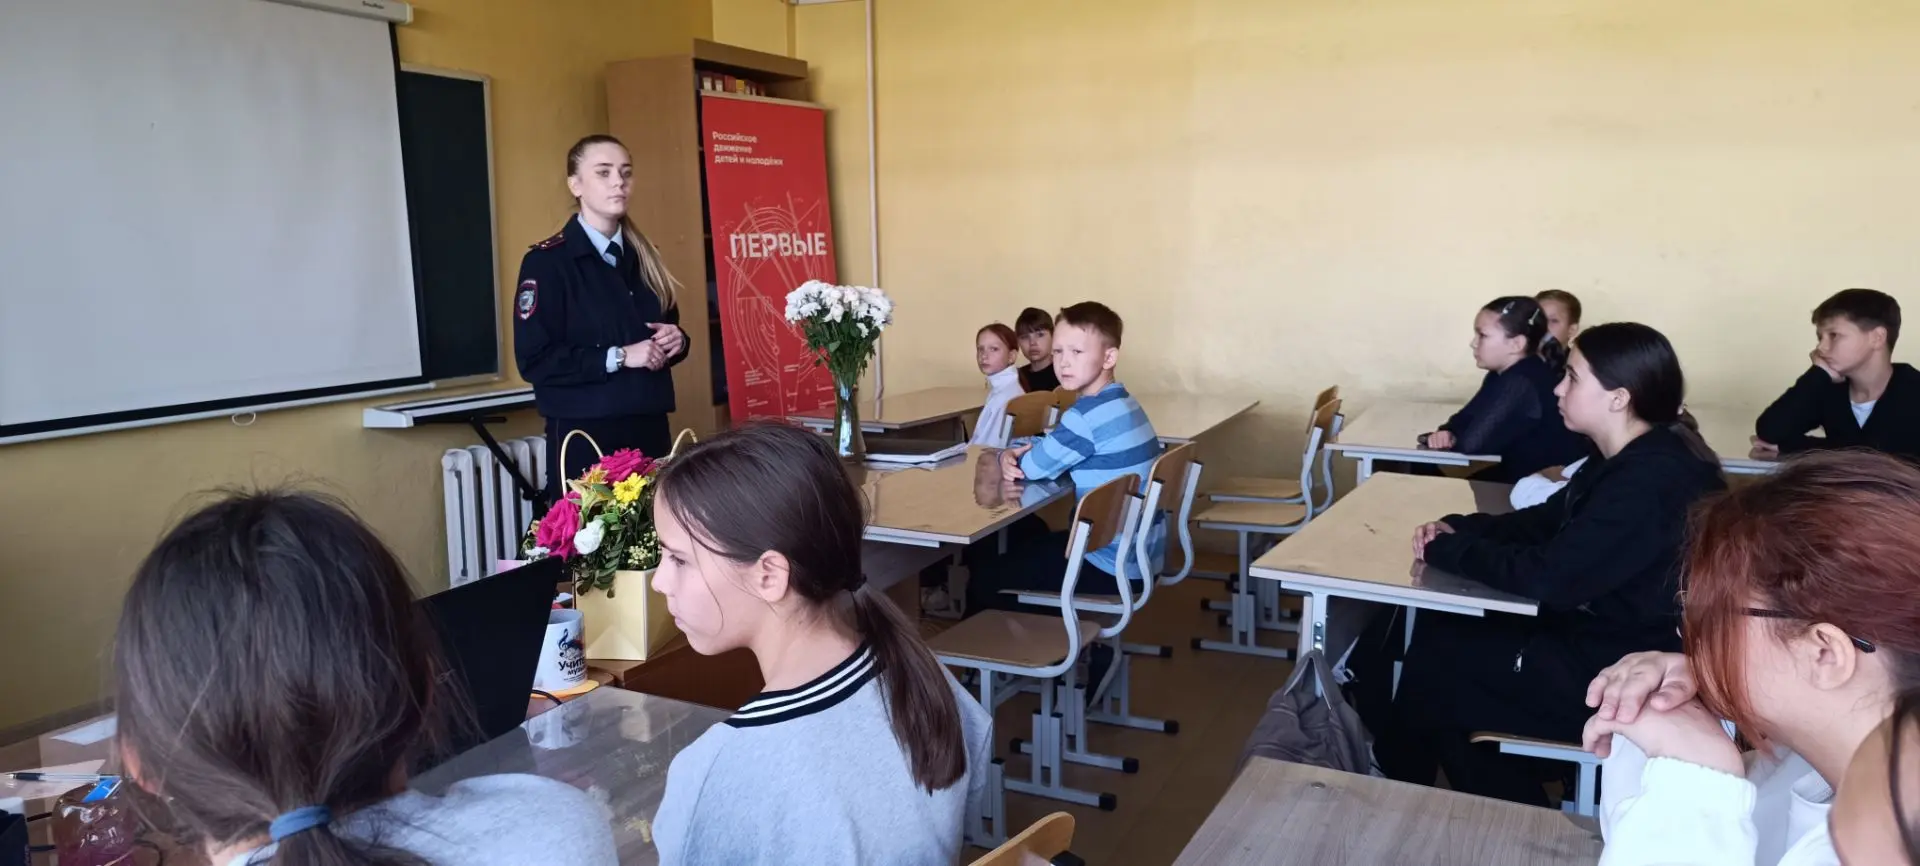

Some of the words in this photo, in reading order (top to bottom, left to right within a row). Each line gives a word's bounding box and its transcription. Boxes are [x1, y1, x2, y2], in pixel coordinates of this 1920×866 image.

[712, 131, 757, 143] Российское
[714, 144, 752, 153] движение
[714, 154, 738, 164] детей
[729, 232, 827, 259] ПЕРВЫЕ
